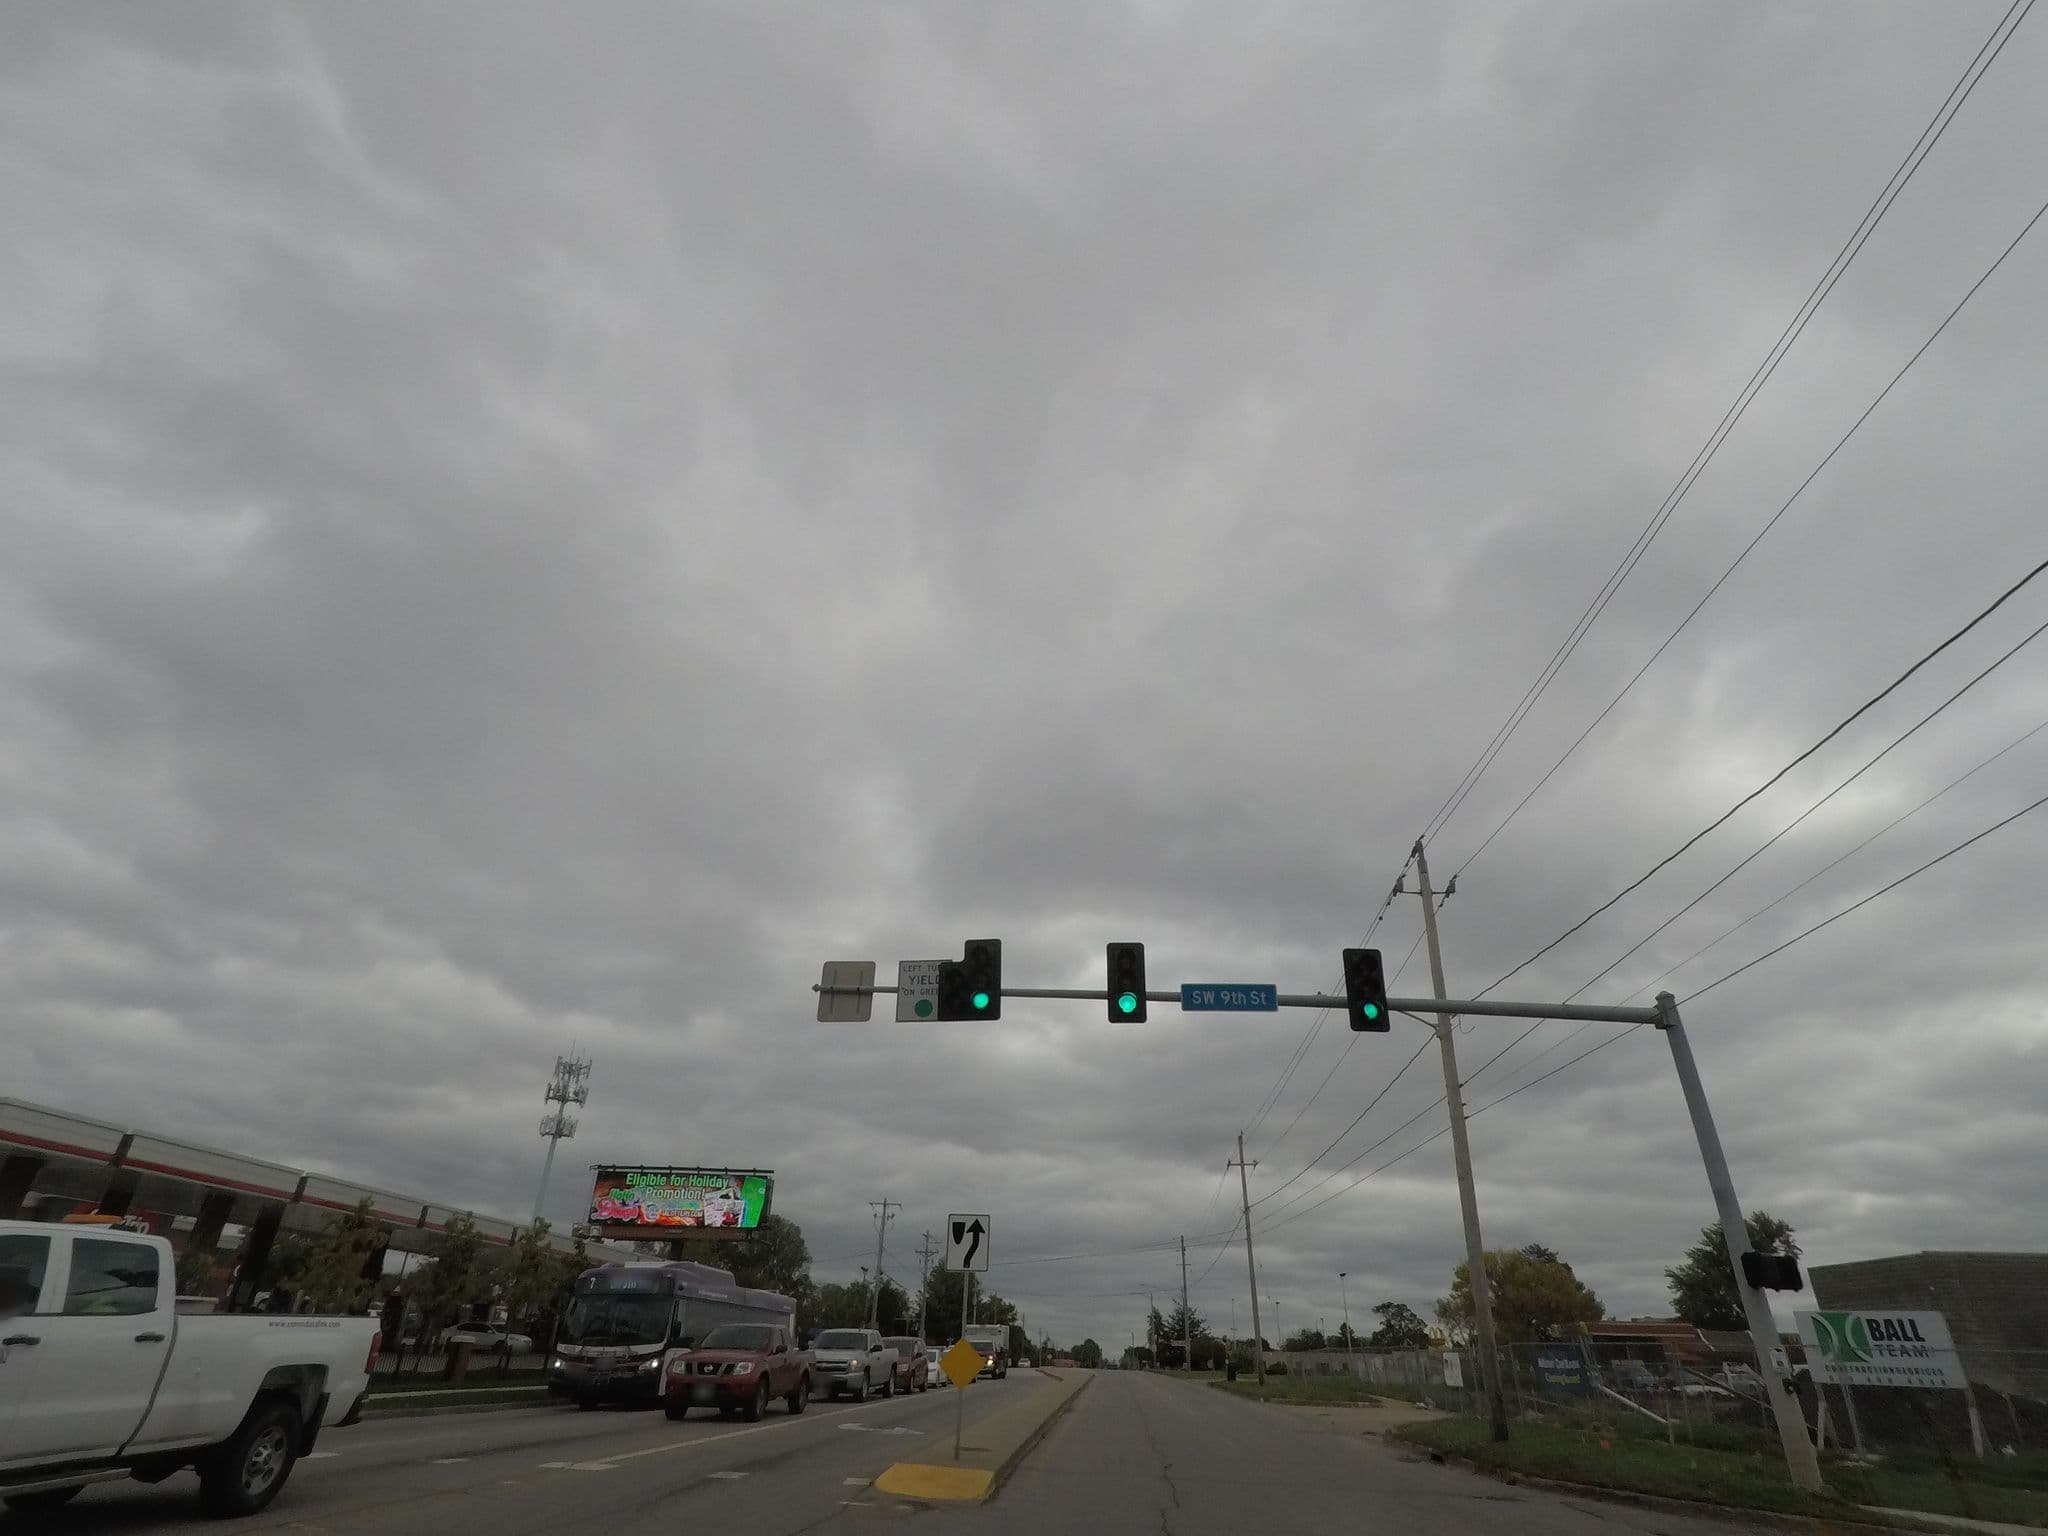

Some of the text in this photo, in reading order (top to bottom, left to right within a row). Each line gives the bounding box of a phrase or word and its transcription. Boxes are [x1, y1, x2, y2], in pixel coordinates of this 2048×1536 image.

[904, 965, 921, 973] LEFT
[904, 988, 915, 996] ON
[1192, 990, 1267, 1005] SW 9th St
[626, 1172, 729, 1190] Eligible for Holiday
[645, 1187, 705, 1200] Promotion!
[1865, 1318, 1926, 1342] BALL
[1874, 1344, 1929, 1358] TEAM
